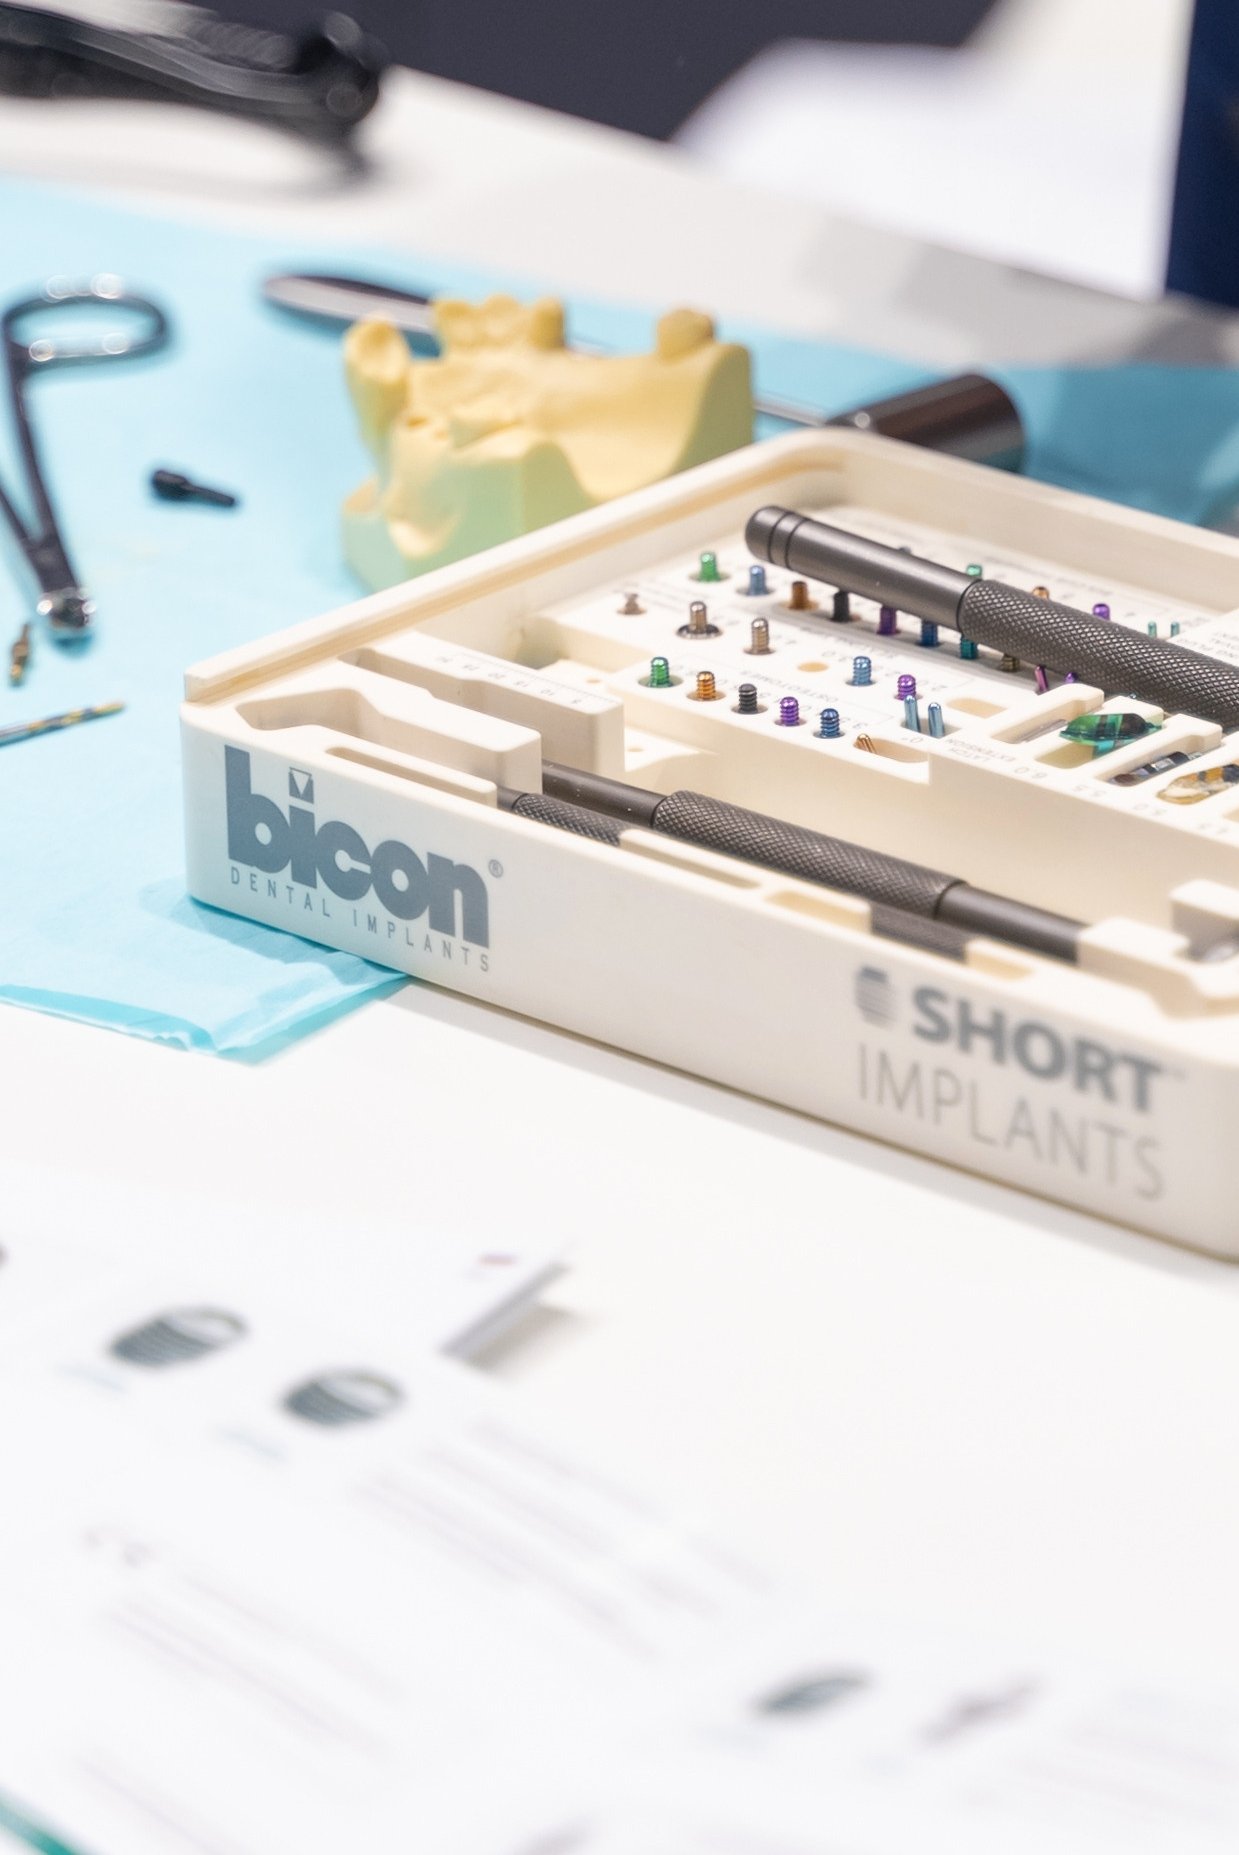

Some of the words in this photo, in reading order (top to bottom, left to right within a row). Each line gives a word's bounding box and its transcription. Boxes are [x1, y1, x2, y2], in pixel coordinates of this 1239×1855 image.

[230, 865, 331, 919] DENTAL
[353, 908, 490, 973] IMPLANTS
[912, 984, 1163, 1116] SHORT
[858, 1042, 1165, 1203] IMPLANTS
